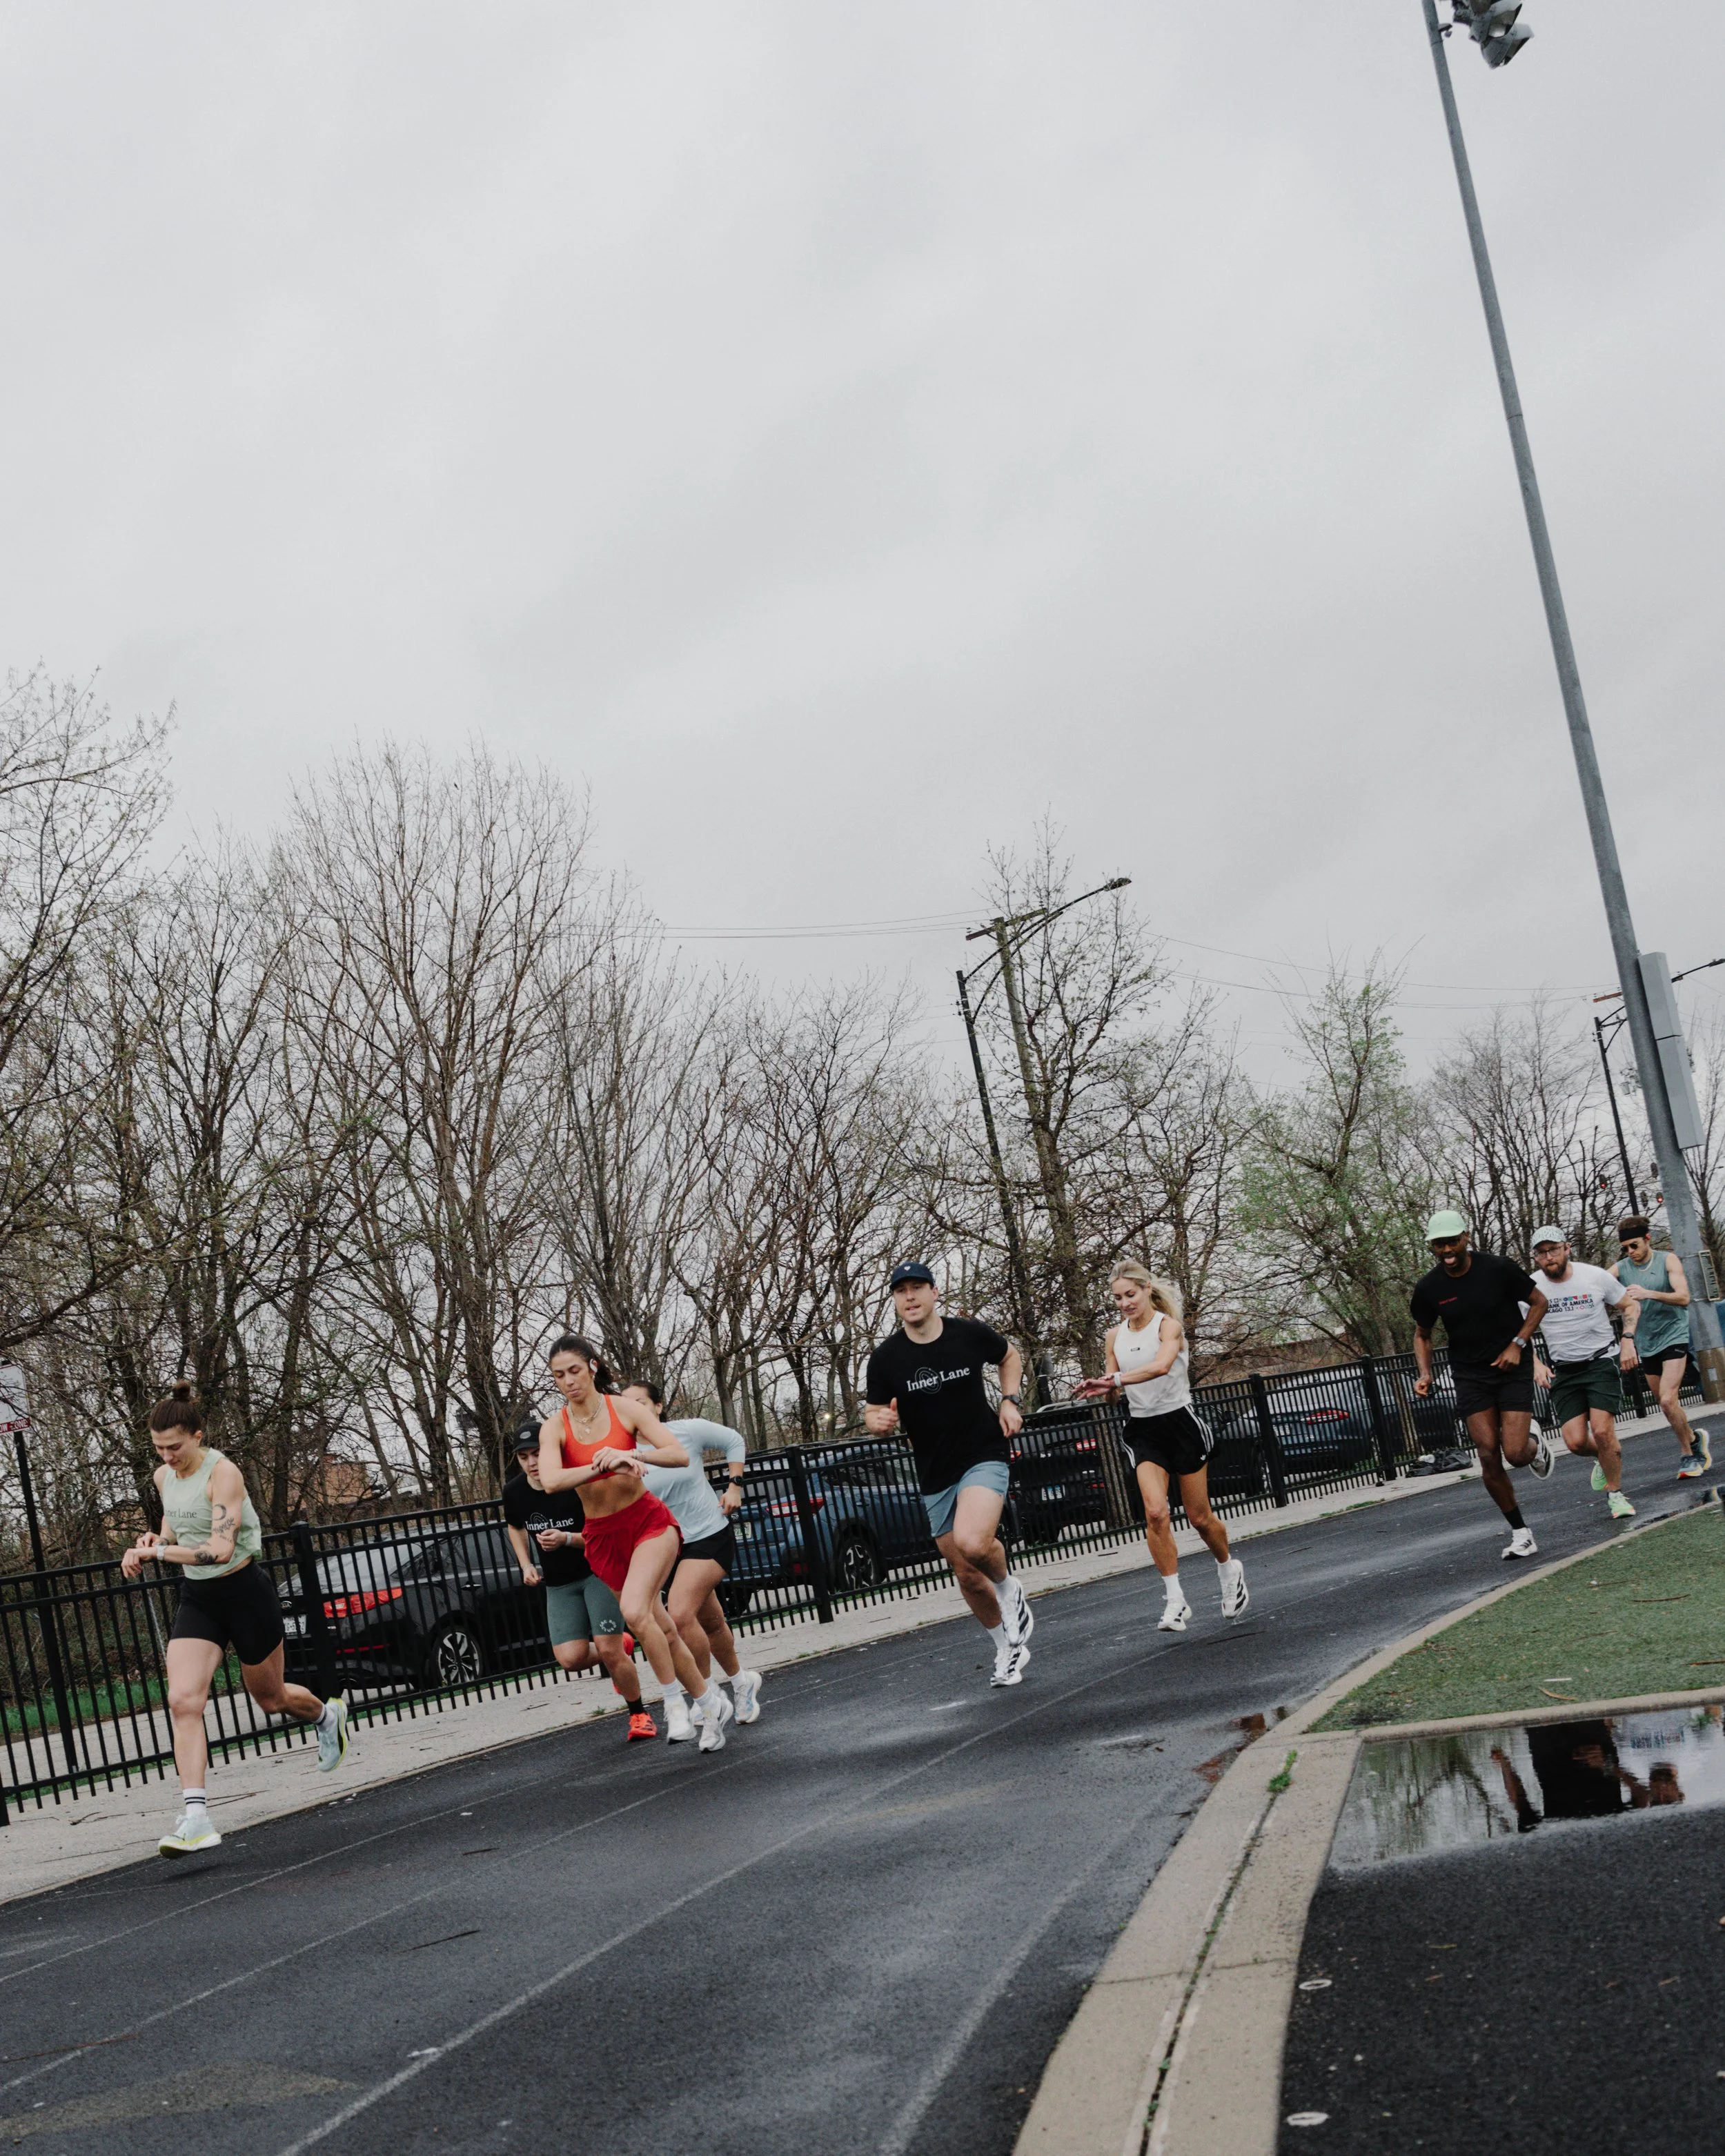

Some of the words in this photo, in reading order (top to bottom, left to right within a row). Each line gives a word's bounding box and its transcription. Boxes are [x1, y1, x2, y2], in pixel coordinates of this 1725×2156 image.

[906, 1376, 938, 1392] Inner
[939, 1367, 970, 1382] Lane
[0, 1423, 8, 1433] OW
[165, 1509, 177, 1519] nner
[179, 1507, 197, 1519] Lane
[525, 1521, 549, 1531] Inner
[549, 1518, 574, 1528] Lane
